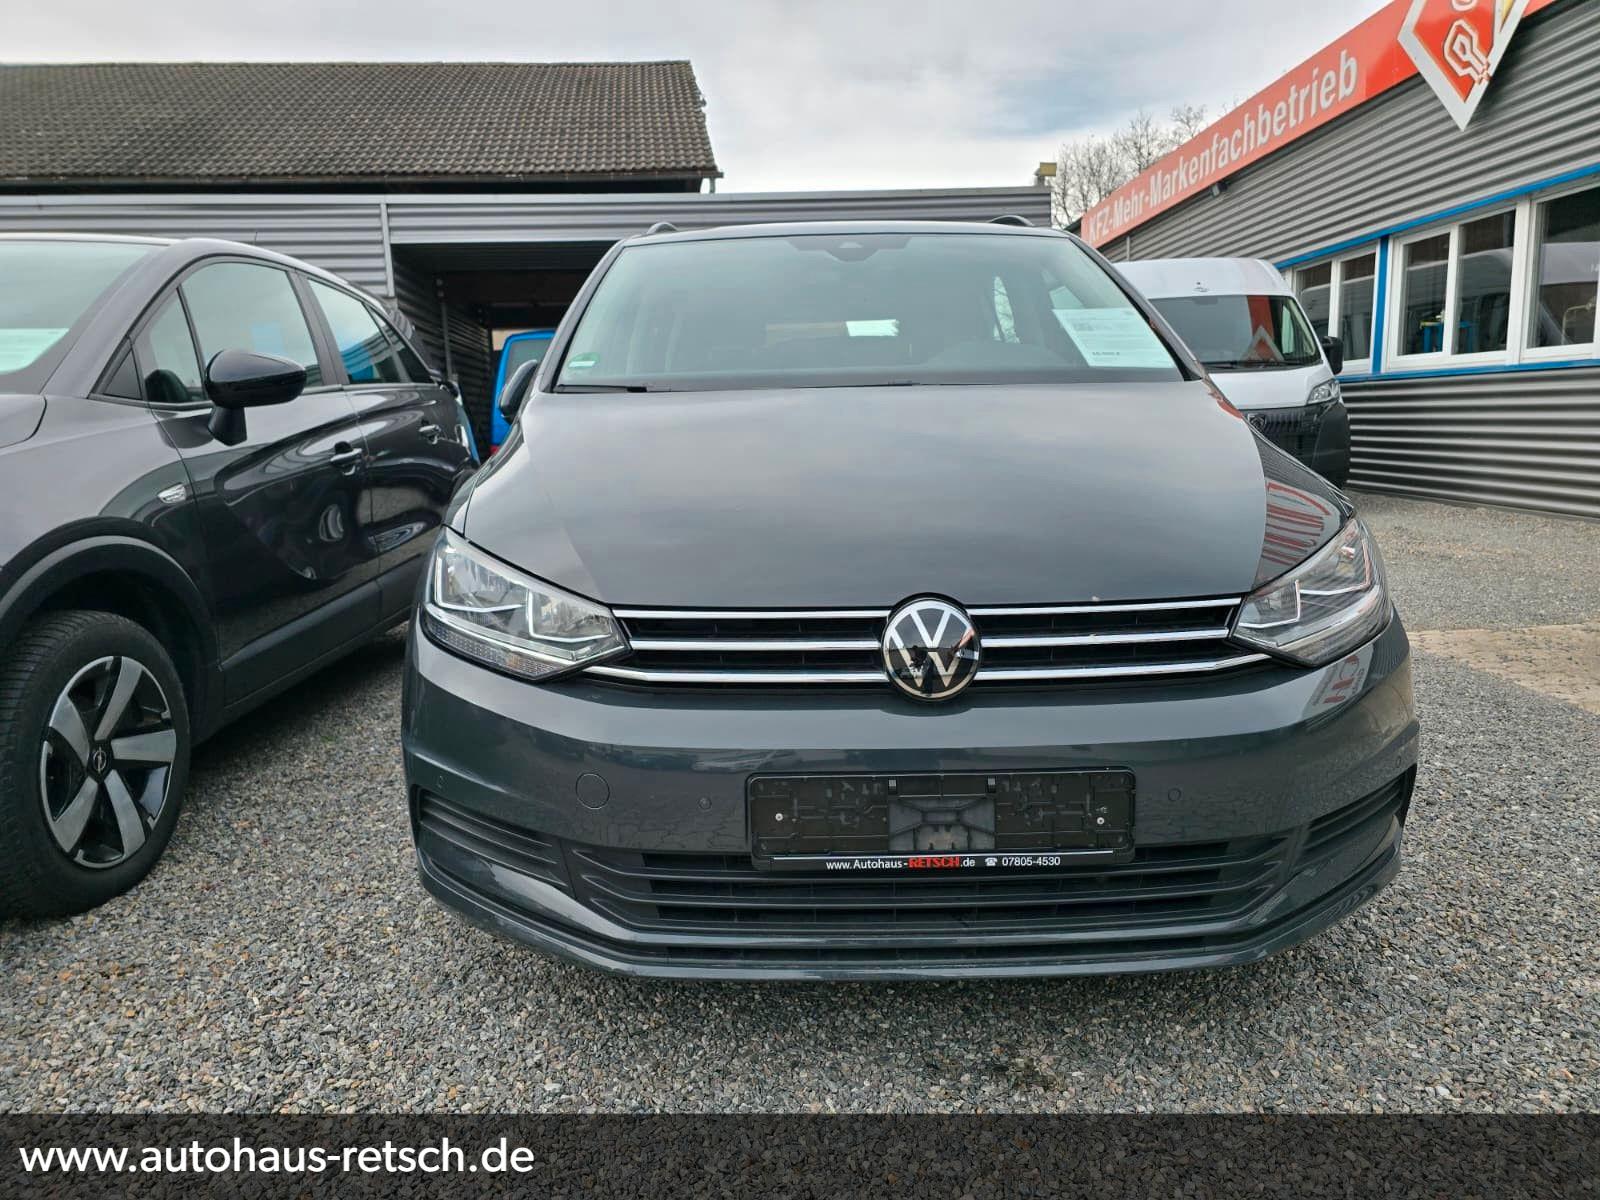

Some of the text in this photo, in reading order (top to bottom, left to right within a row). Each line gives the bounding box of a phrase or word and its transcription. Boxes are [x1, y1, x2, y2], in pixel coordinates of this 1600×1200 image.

[1088, 48, 1359, 243] KFZ-Mehr-Markenfachbetrieb
[825, 856, 1062, 871] www.Autohaus-RETSCH.de 07805-4530
